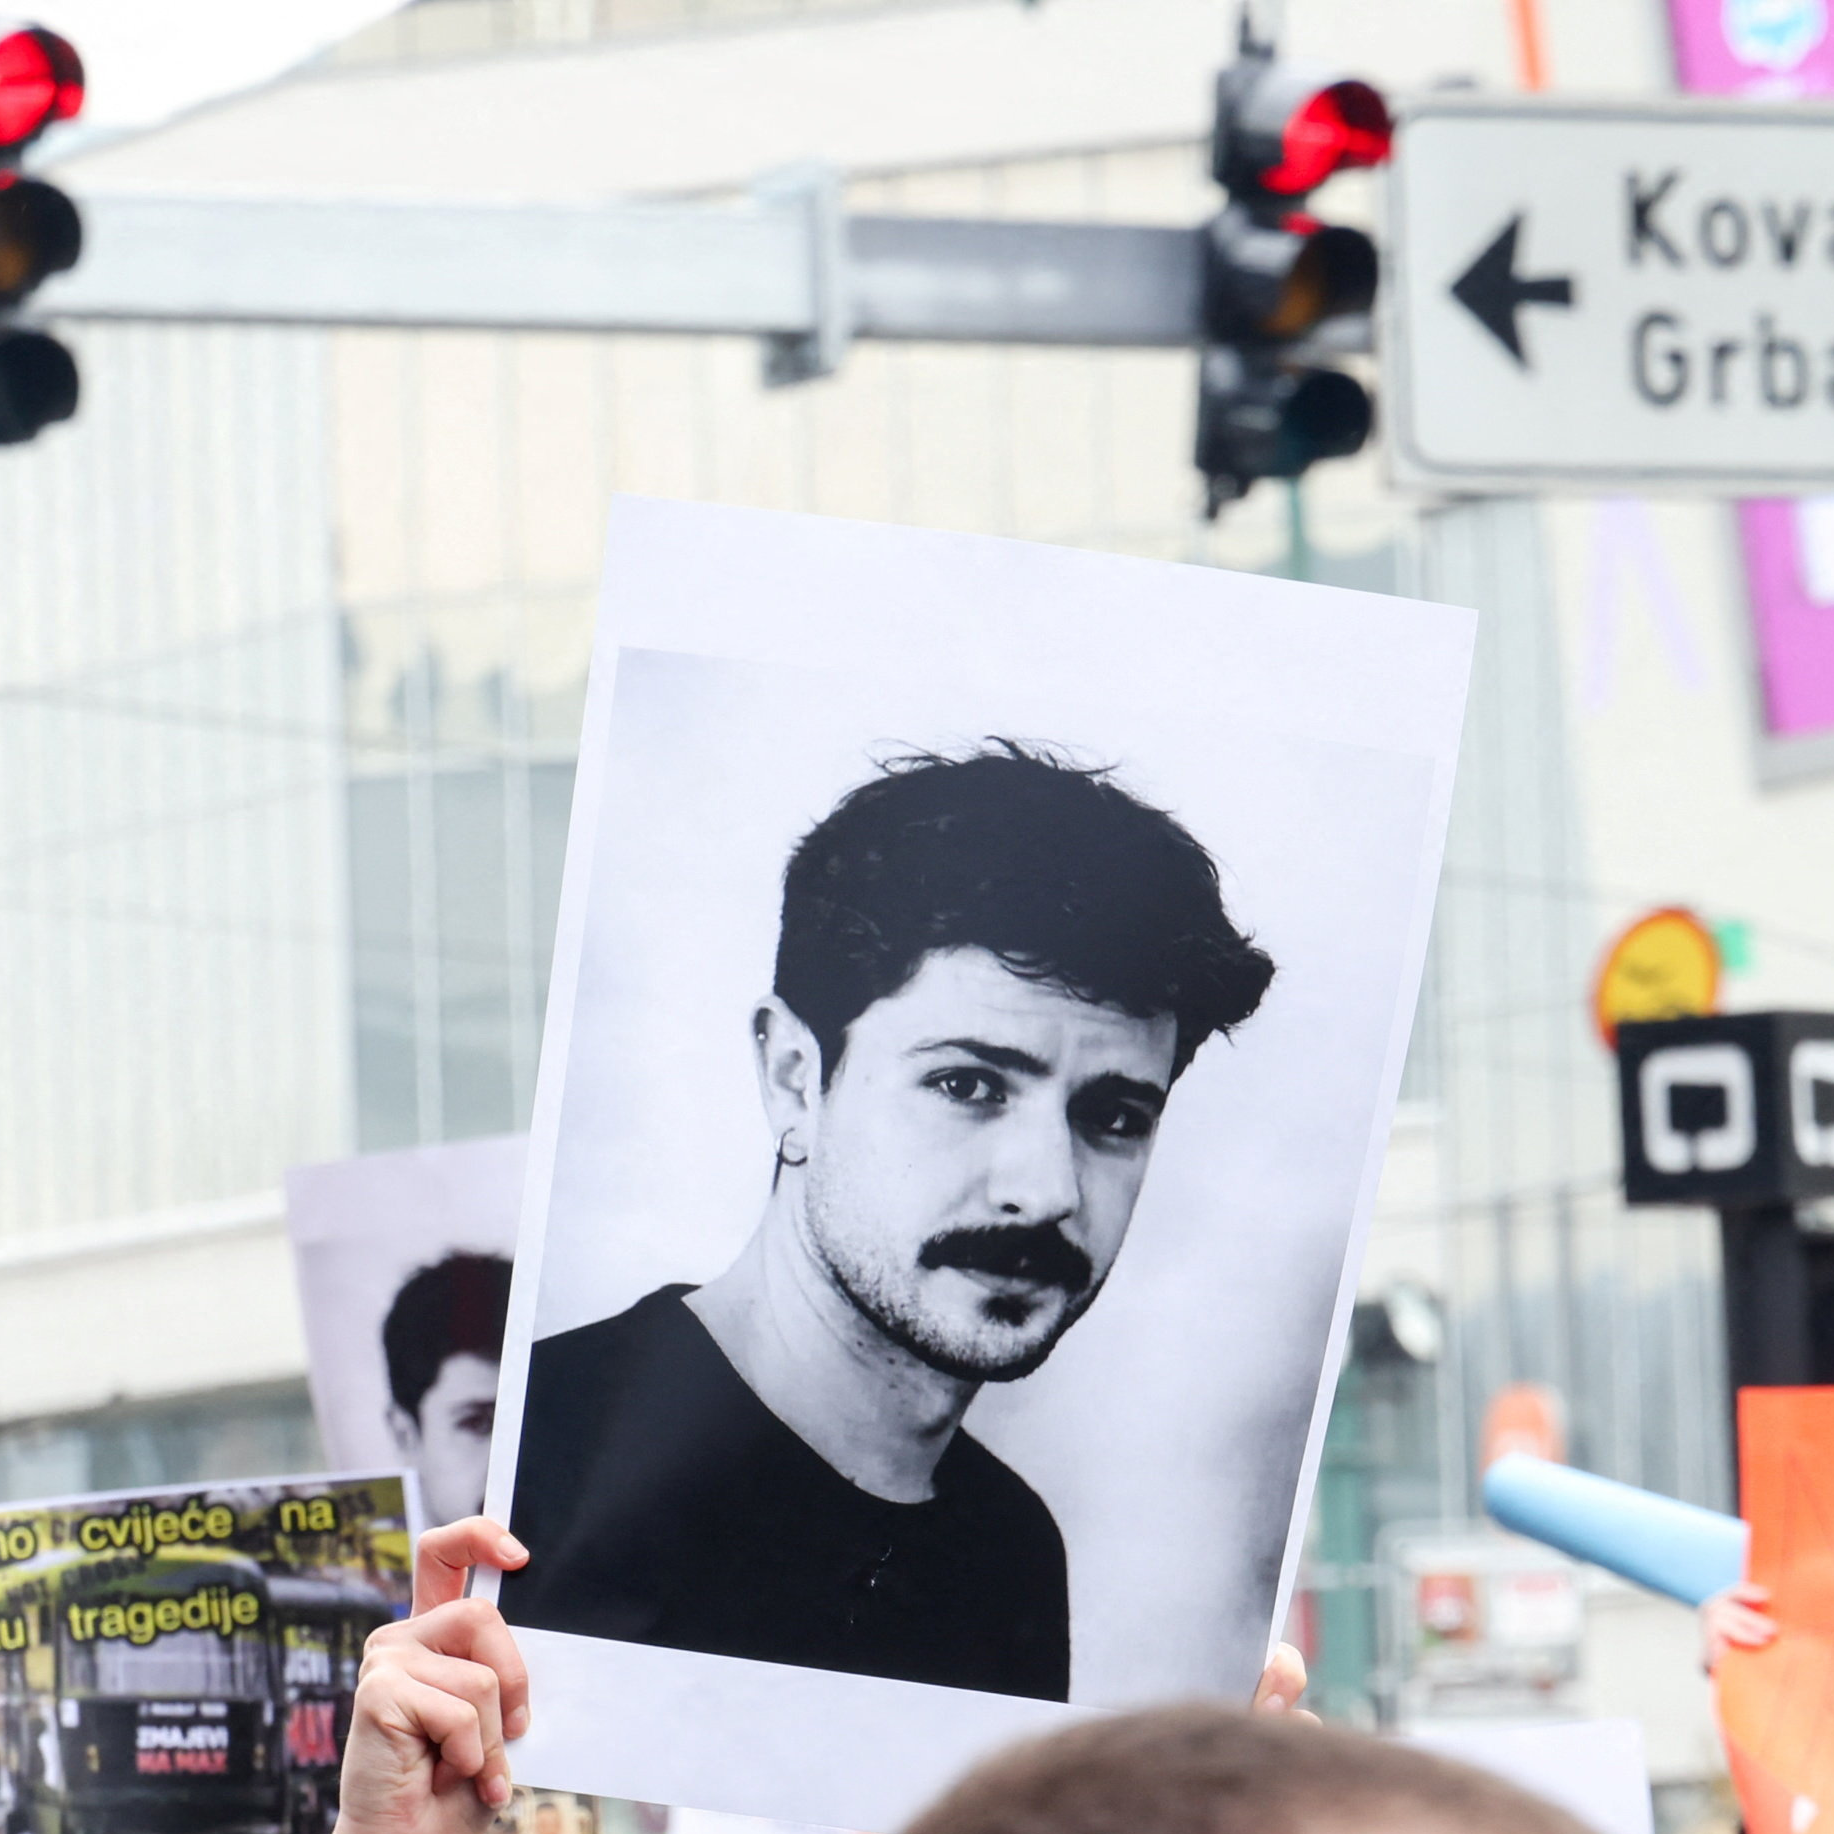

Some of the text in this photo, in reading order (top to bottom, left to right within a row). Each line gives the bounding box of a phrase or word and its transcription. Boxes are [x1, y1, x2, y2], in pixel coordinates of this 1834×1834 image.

[79, 1498, 234, 1554] cvijeće
[279, 1497, 336, 1533] na
[68, 1586, 259, 1645] tragedije
